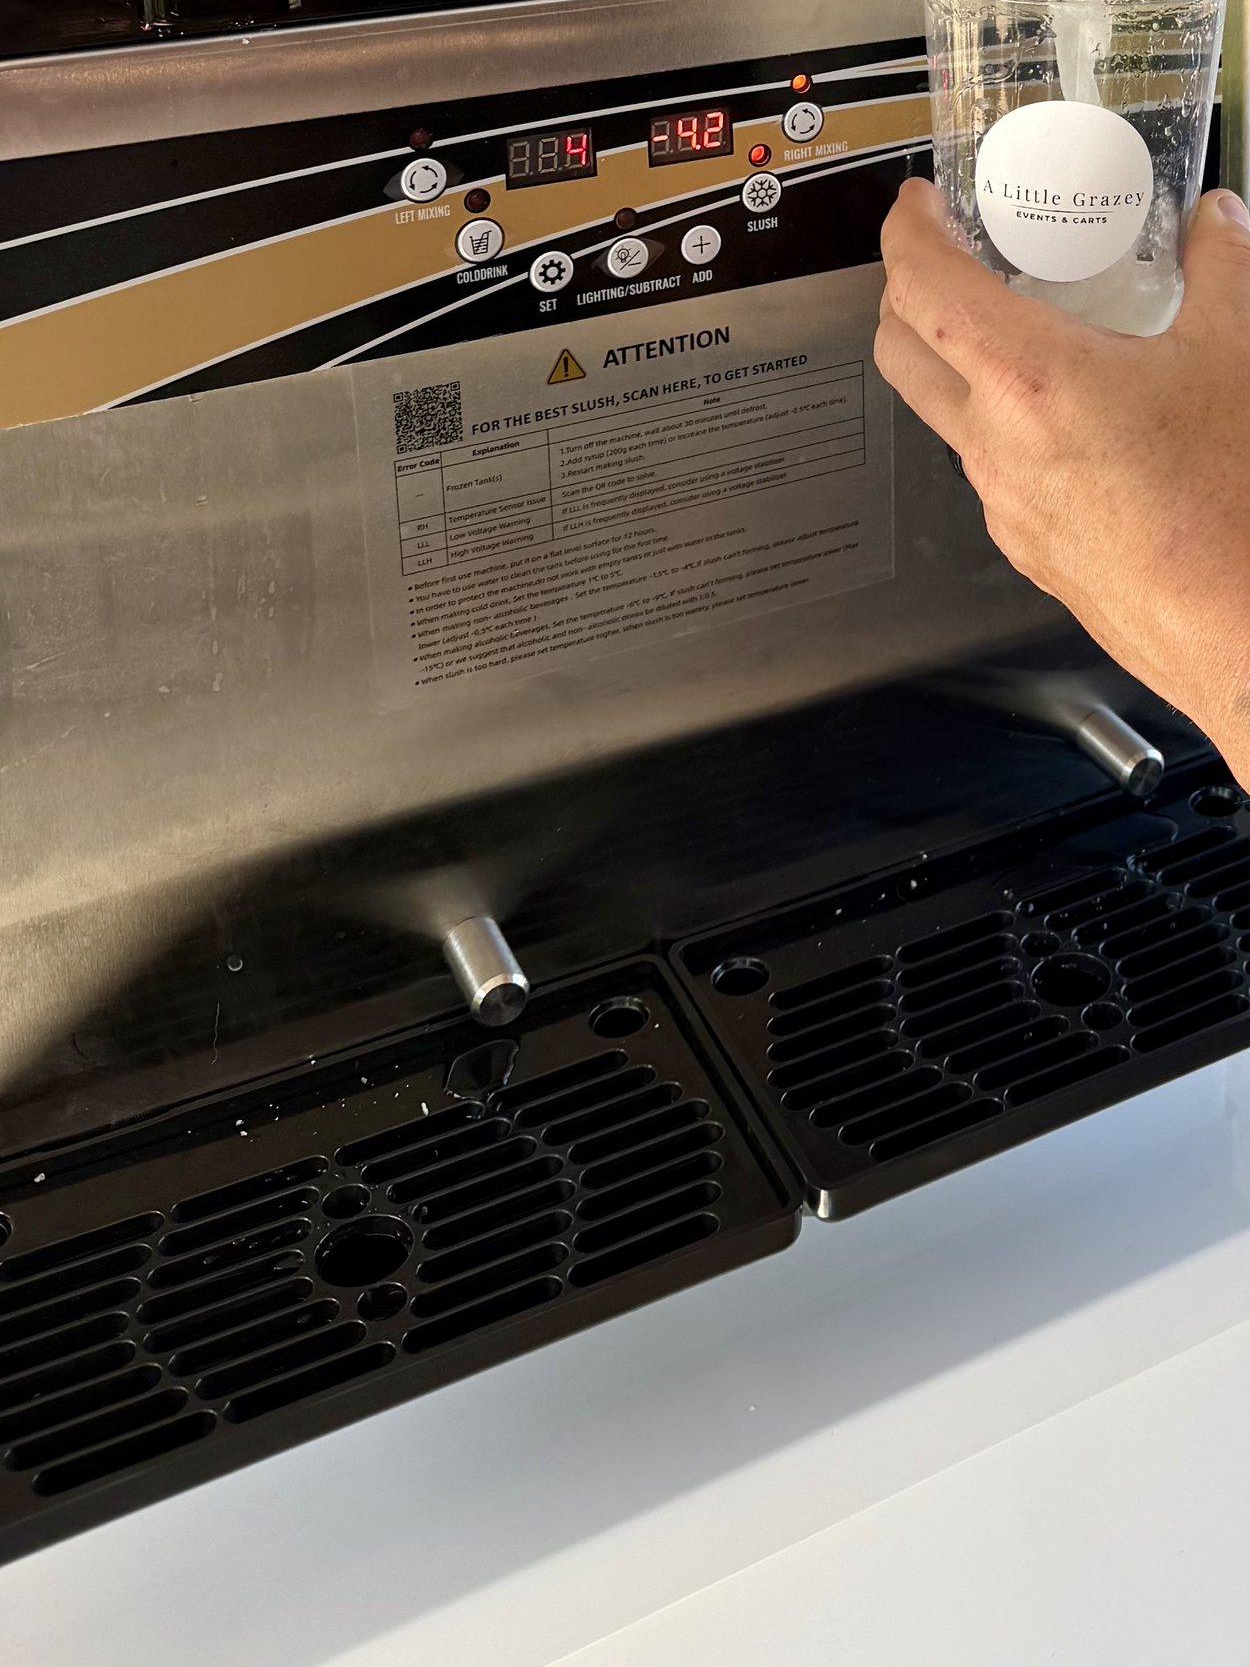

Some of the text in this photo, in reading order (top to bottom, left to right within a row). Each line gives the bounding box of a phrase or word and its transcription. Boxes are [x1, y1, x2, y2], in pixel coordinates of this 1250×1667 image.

[651, 111, 726, 151] -4.2
[783, 140, 849, 162] RIGHT MIXING
[983, 179, 1146, 208] A Little Grazey
[395, 204, 451, 225] LEFT MIXING
[747, 216, 779, 234] SLUSH
[1016, 210, 1109, 225] EVENTS & CARTS
[456, 264, 509, 285] COLDDRINK
[576, 268, 714, 307] LIGHTING/SUBTRACT ADD
[539, 298, 558, 314] SET
[602, 325, 731, 370] ATTENTION
[472, 354, 807, 435] FOR THE BEST SLUSH, SCAN HERE, TO GET STARTED
[703, 396, 720, 406] Note
[472, 440, 519, 457] Explanation
[397, 457, 439, 473] Error Code
